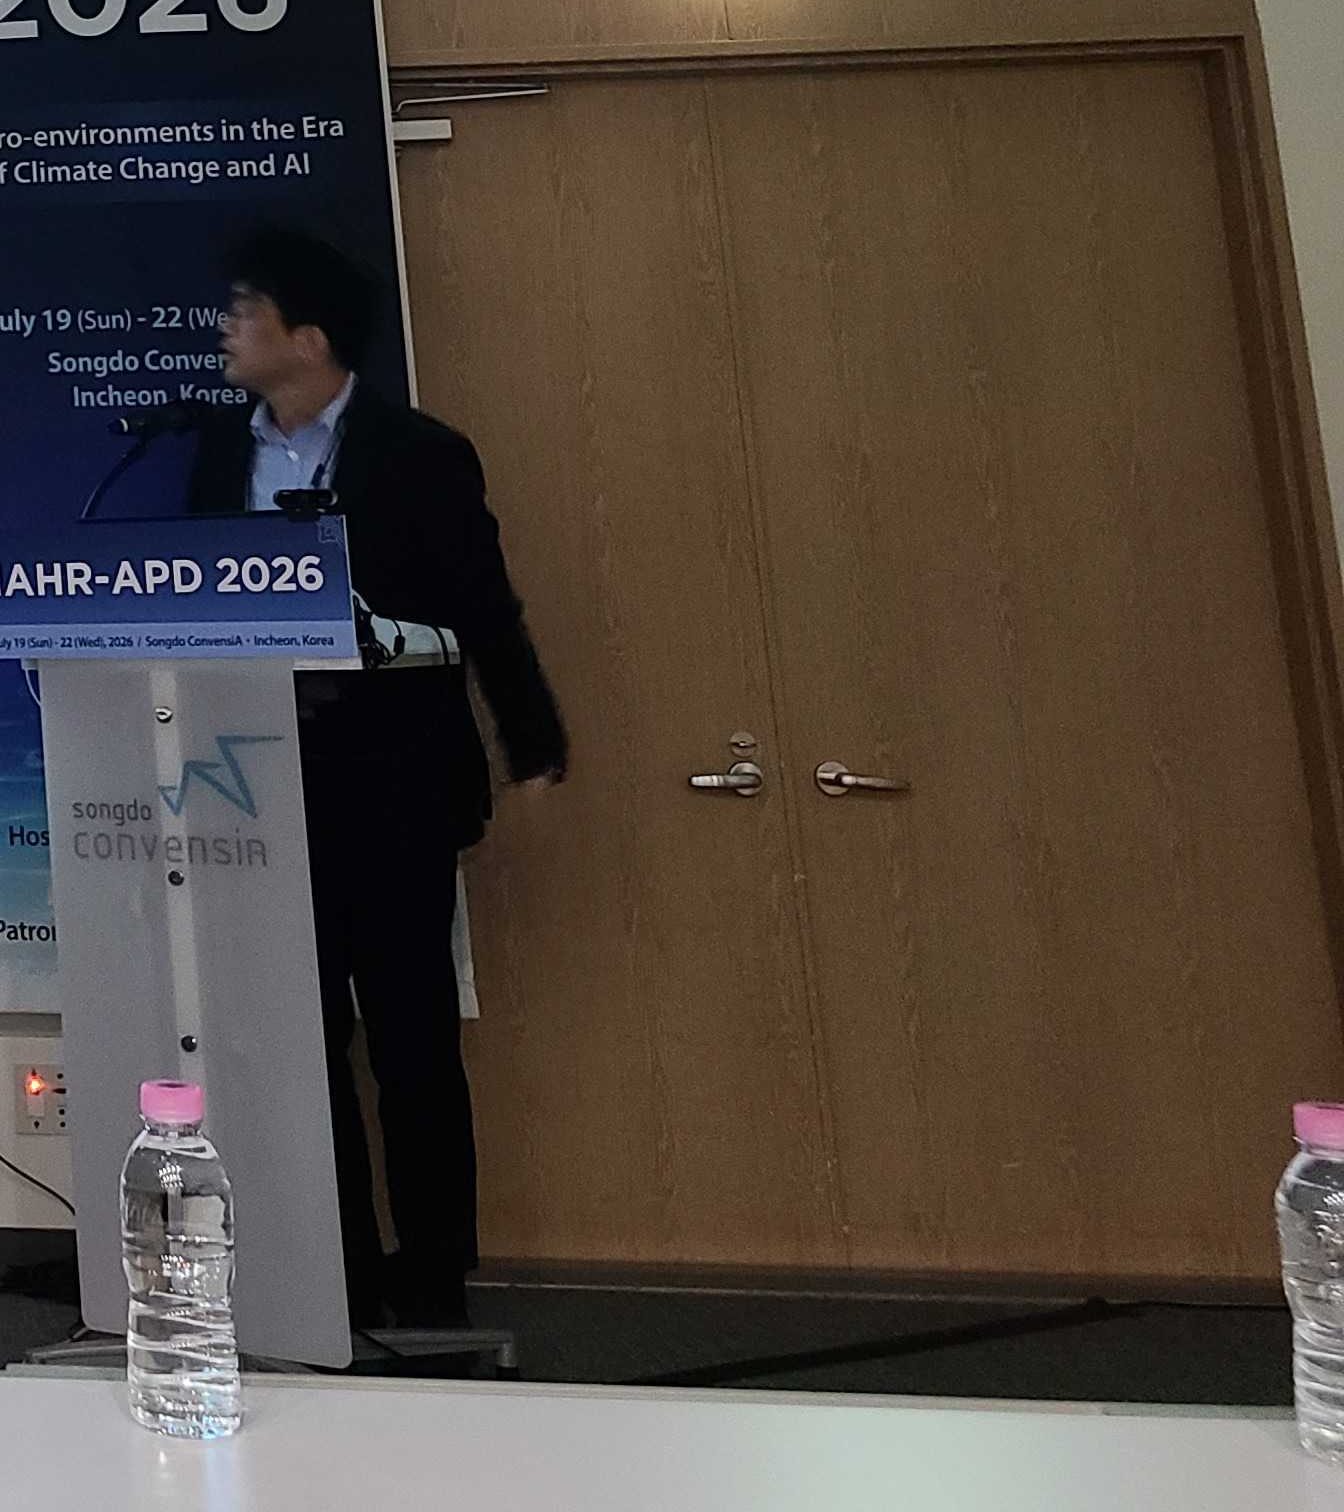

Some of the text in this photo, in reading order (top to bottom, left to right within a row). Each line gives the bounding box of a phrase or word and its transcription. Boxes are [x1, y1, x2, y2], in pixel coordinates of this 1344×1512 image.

[221, 120, 245, 141] in
[251, 118, 295, 140] the
[302, 116, 344, 138] Era
[14, 159, 113, 183] Climate
[119, 157, 220, 184] Change
[226, 154, 275, 177] and
[283, 152, 310, 175] AI
[42, 308, 71, 330] 19
[77, 307, 132, 333] (Sun)
[151, 306, 183, 328] 22
[47, 351, 140, 377] Songdo
[180, 384, 248, 405] Korea
[215, 556, 324, 593] 2026
[14, 638, 26, 648] 19
[28, 637, 53, 649] (Sun)
[61, 637, 73, 648] 22
[109, 636, 133, 648] 2026
[145, 635, 186, 650] Songdo
[187, 635, 243, 647] ConvensiA
[254, 635, 300, 646] Incheon,
[303, 635, 334, 646] Korea
[72, 799, 152, 826] songdo
[9, 825, 50, 846] Hos
